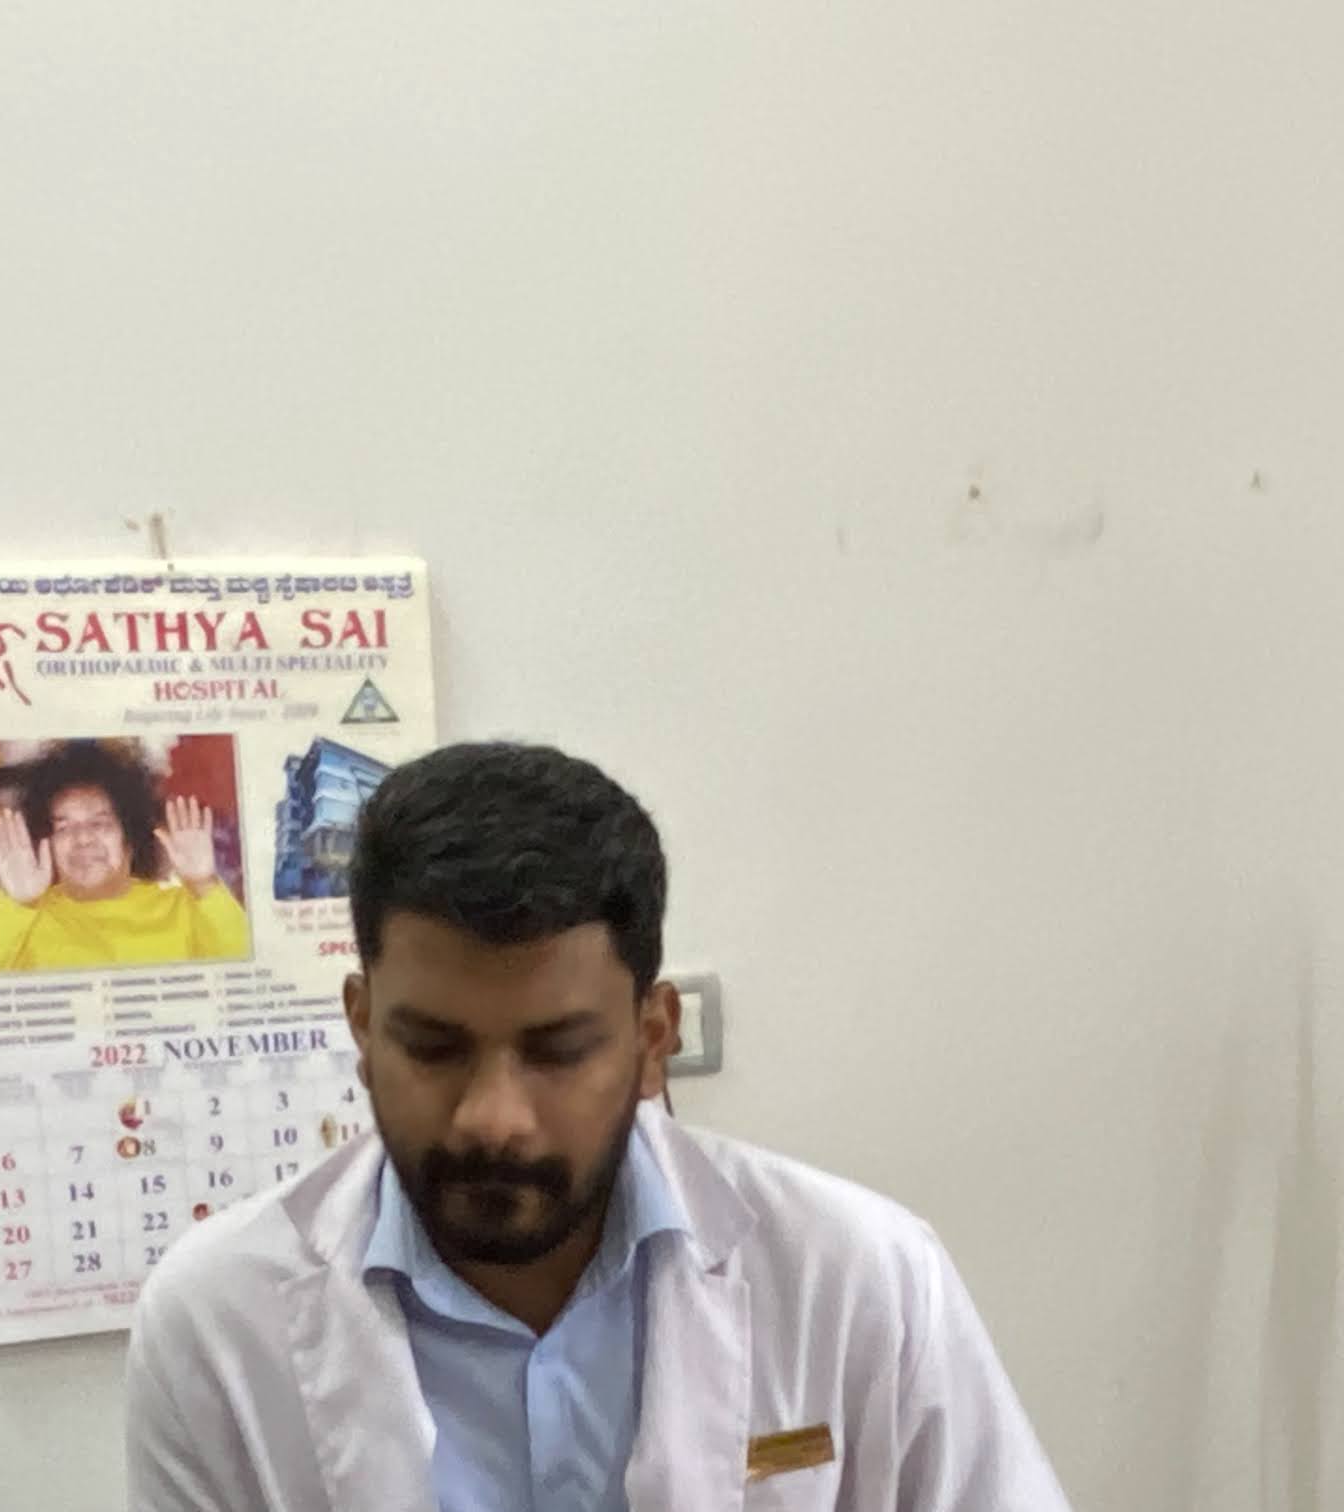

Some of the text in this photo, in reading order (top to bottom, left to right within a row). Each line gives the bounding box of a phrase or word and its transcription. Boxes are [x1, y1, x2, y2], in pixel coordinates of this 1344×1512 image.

[36, 608, 389, 653] SATHYA SAI
[36, 657, 184, 677] ORTHOPAEDIC
[189, 658, 202, 673] &
[154, 679, 279, 701] HOSPITAL
[89, 1043, 148, 1069] 2022
[162, 1028, 330, 1061] NOVEMBER
[207, 1096, 222, 1117] 2
[275, 1091, 289, 1111] 3
[341, 1087, 355, 1106] 4
[0, 1153, 17, 1173] 6
[70, 1146, 85, 1165] 7
[142, 1138, 157, 1158] 8
[209, 1134, 224, 1153] 9
[272, 1127, 298, 1149] 10
[0, 1161, 300, 1210] 13 14 15 16 17
[2, 1212, 169, 1246] 20 21 22
[5, 1259, 33, 1281] 27
[73, 1252, 103, 1274] 28
